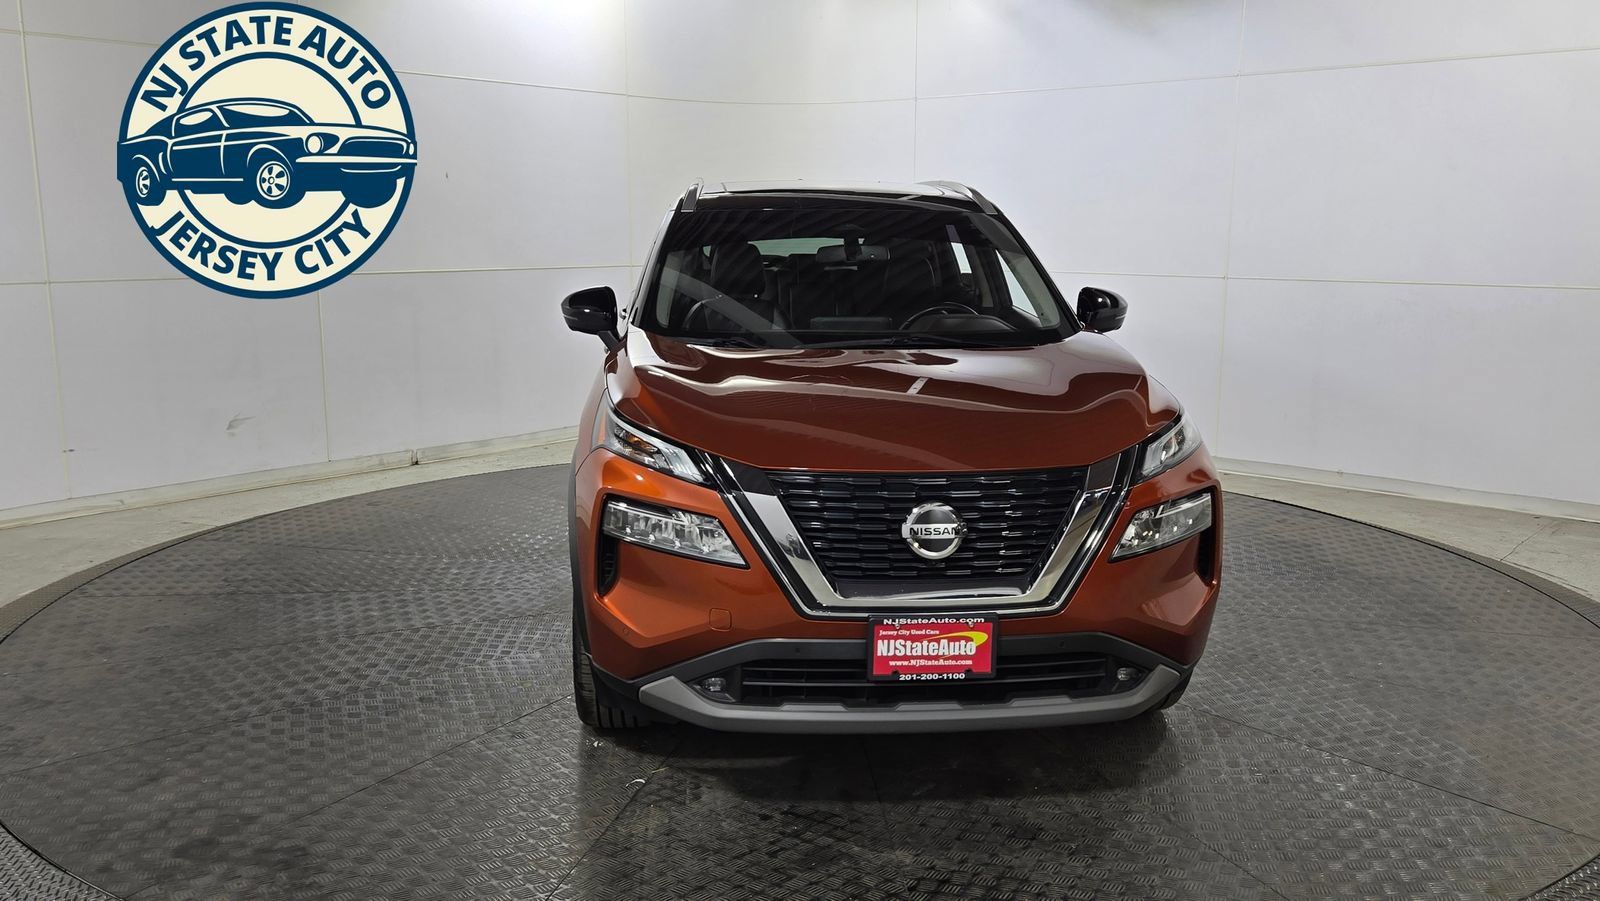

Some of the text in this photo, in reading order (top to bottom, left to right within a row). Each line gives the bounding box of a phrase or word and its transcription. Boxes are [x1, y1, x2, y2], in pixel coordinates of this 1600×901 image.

[909, 527, 959, 536] NISSAN
[883, 617, 985, 625] NJStateAuto.com
[877, 639, 977, 656] NJStateAuto
[889, 659, 973, 667] www.NJStateAuto.com
[899, 673, 965, 681] 201-200-1100
